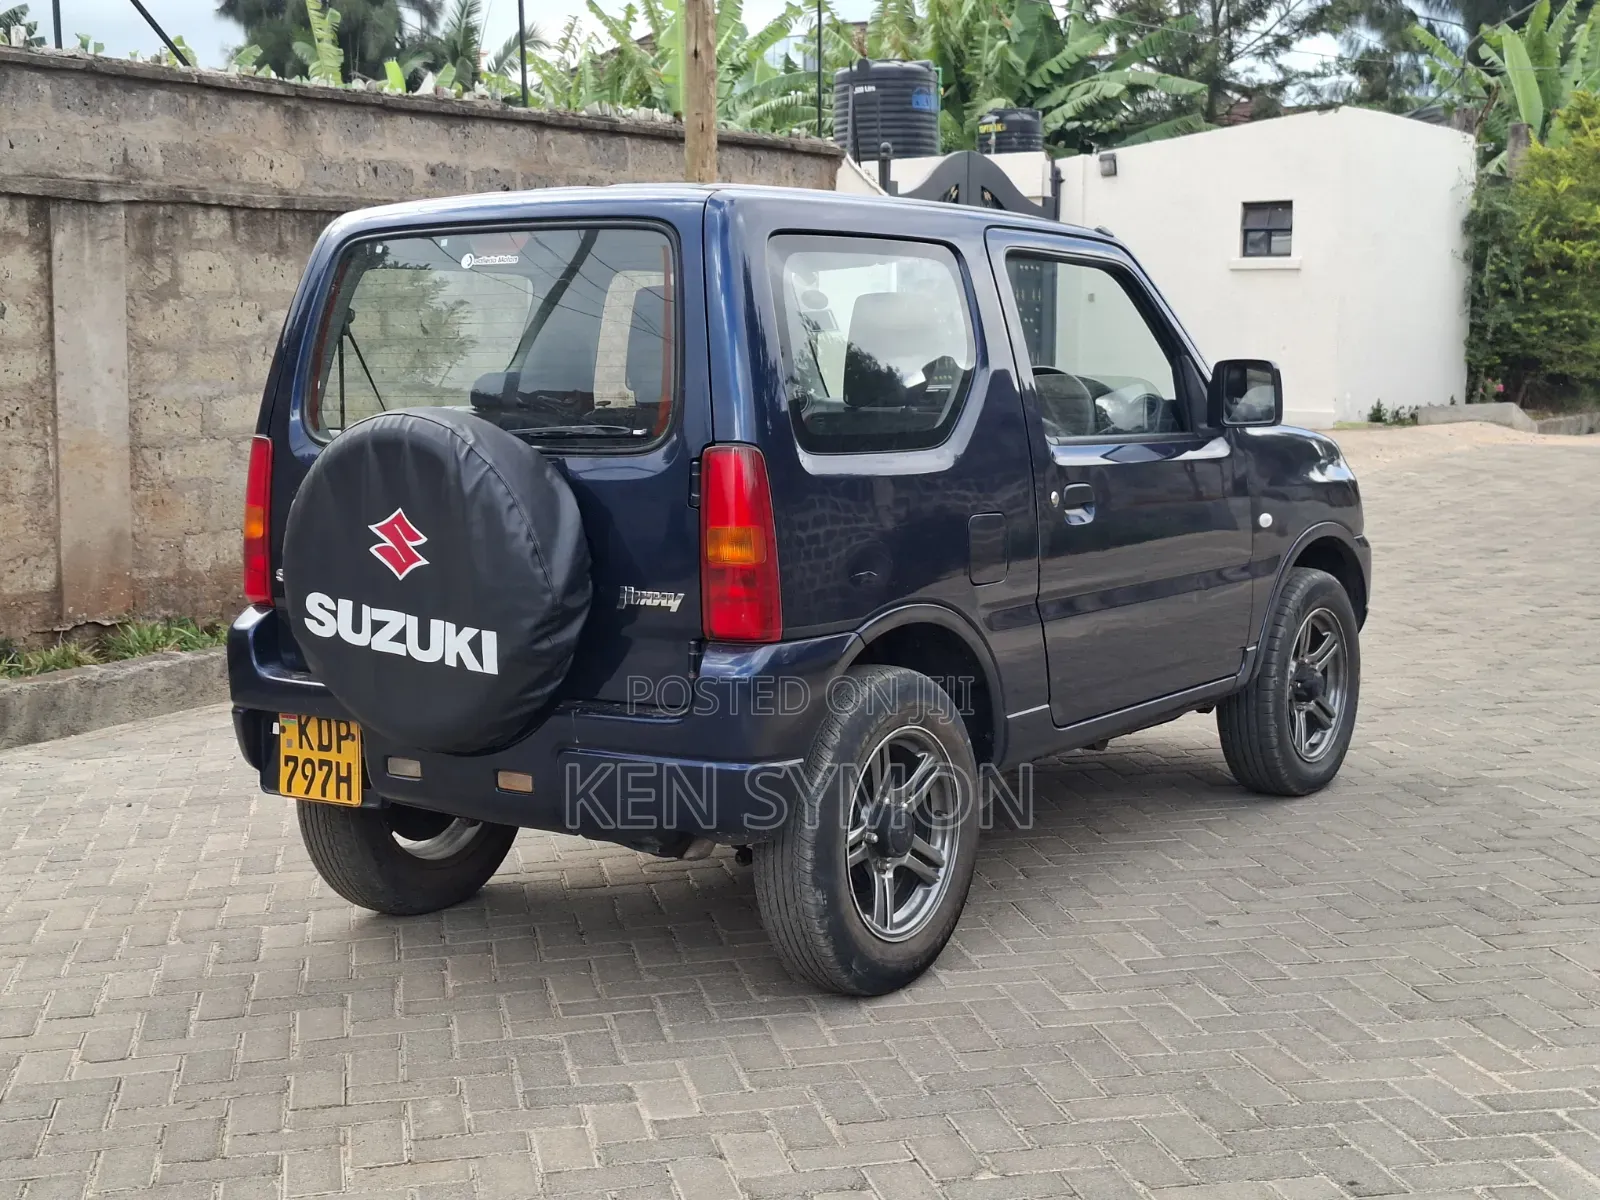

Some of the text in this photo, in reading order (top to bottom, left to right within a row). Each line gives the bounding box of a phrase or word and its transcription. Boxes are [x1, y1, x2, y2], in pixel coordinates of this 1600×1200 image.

[304, 592, 498, 675] SUZUKI
[298, 715, 351, 754] KDP
[284, 755, 352, 801] 797H
